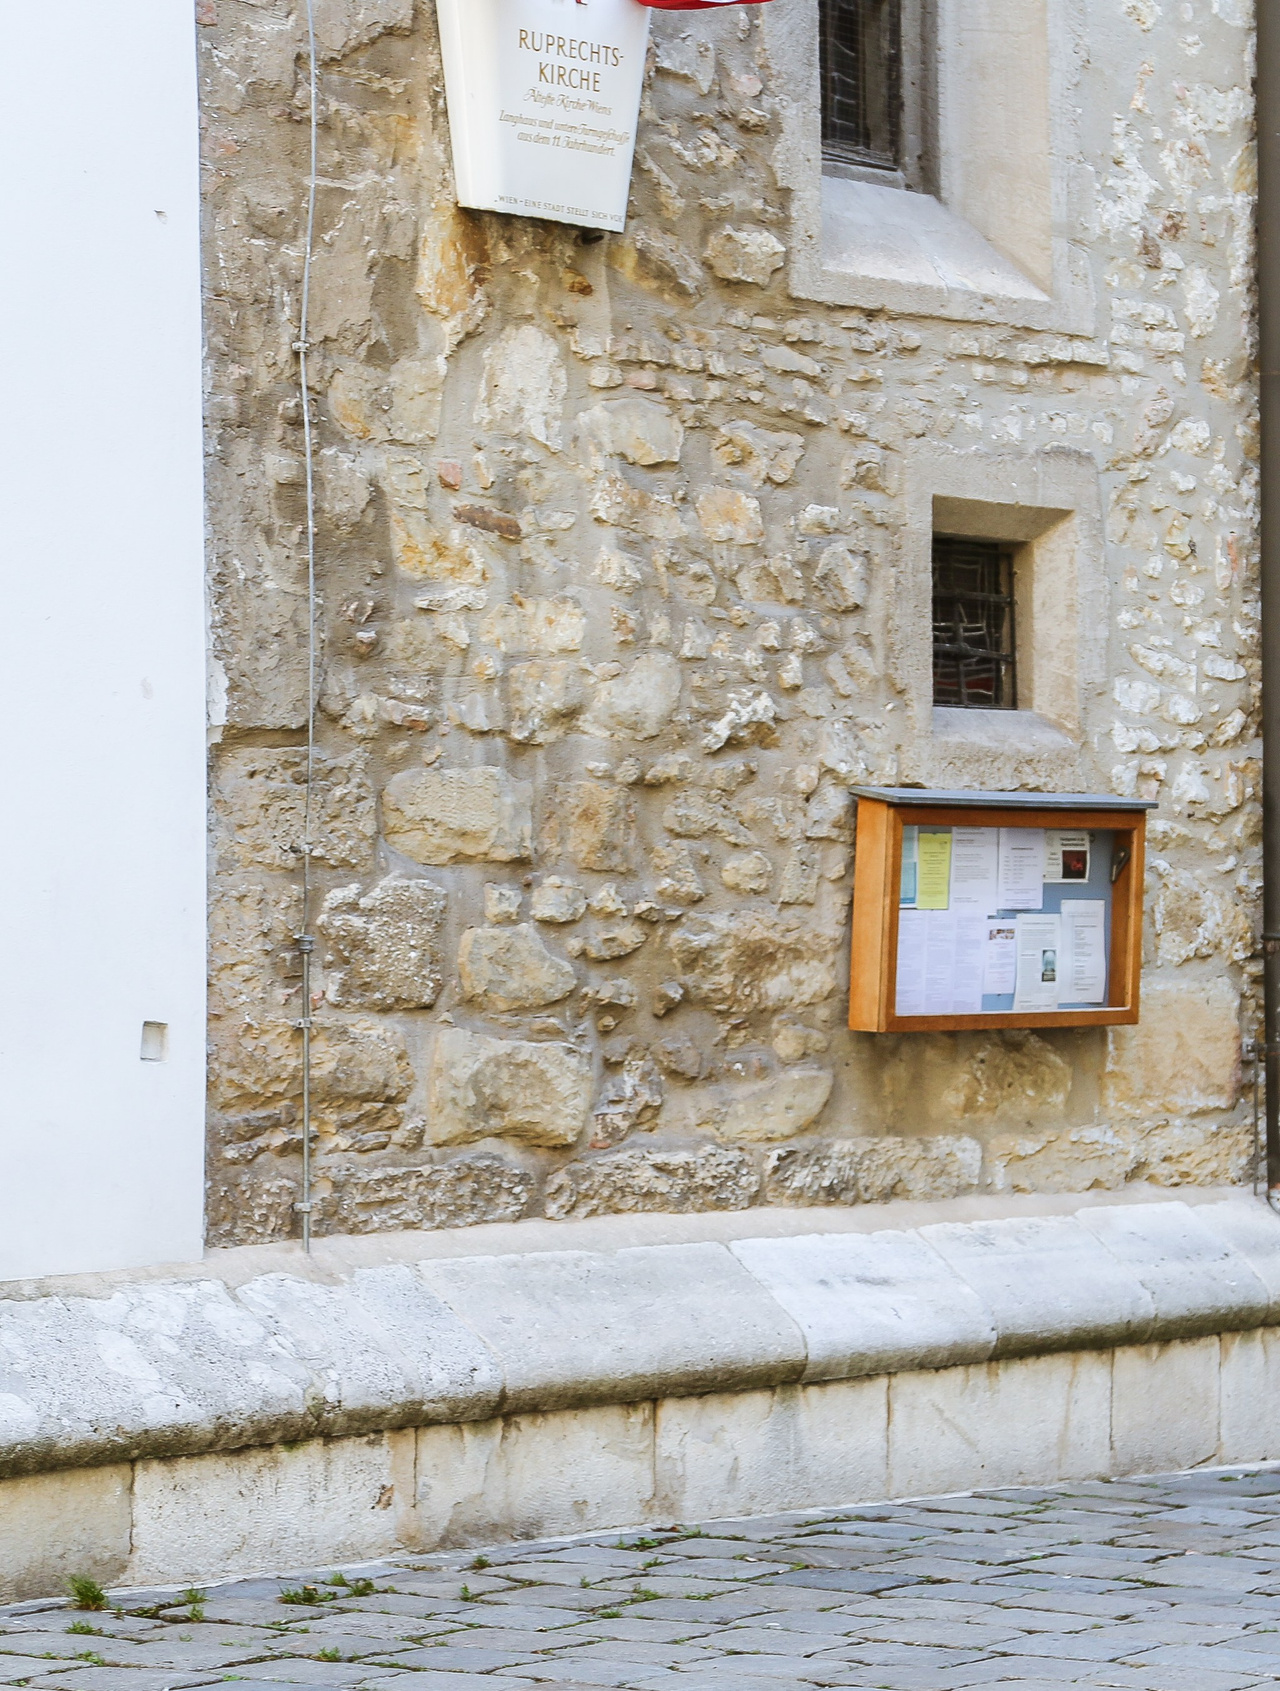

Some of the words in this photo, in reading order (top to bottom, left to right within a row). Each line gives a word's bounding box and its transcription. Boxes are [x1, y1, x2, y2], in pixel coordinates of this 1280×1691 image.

[519, 28, 624, 67] RUPRECHTS-
[538, 61, 601, 92] KIRCHE
[556, 93, 588, 112] Kirche
[586, 99, 612, 115] Wiens
[538, 119, 554, 129] und
[517, 131, 533, 142] aus
[533, 132, 550, 145] dem
[525, 199, 541, 209] EINE
[543, 202, 565, 213] STADT
[566, 206, 589, 217] STELLT
[591, 210, 607, 220] SICH
